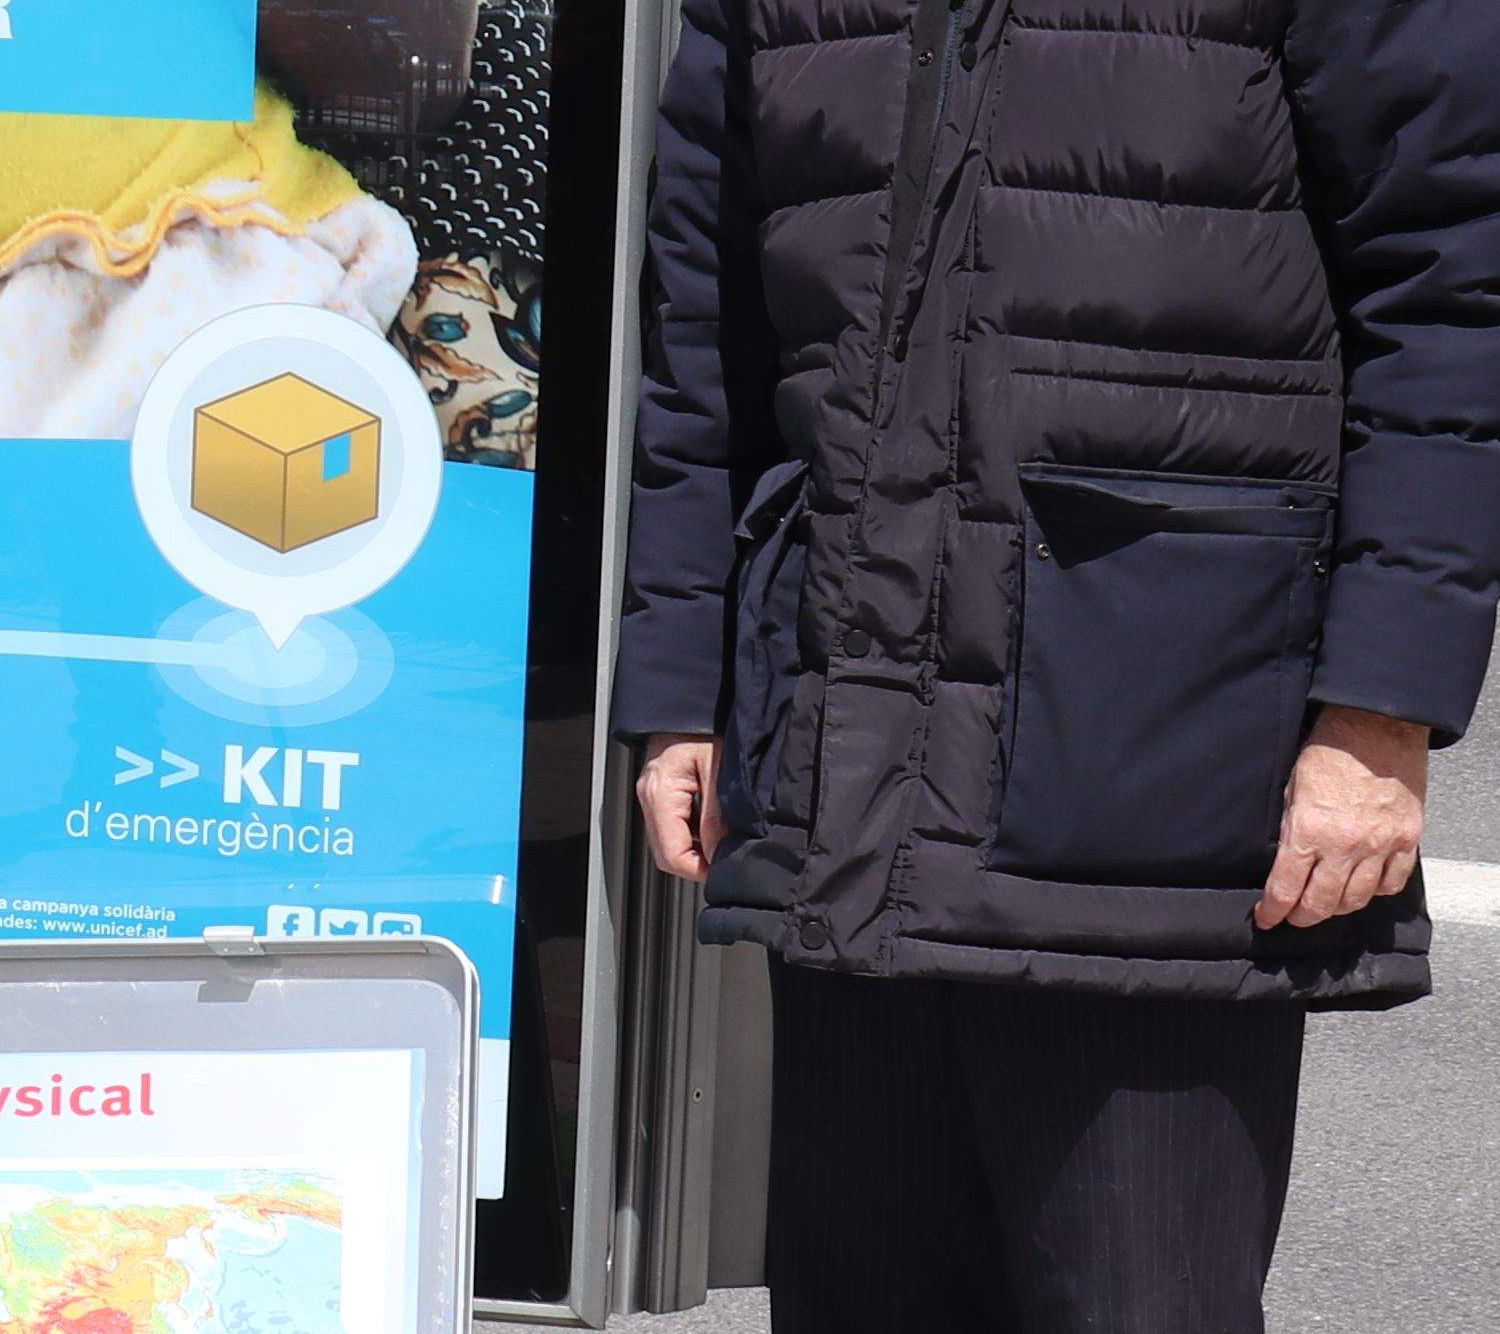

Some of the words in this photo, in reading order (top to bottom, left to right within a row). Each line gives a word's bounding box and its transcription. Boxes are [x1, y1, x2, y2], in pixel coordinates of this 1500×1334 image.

[223, 743, 360, 811] KIT
[12, 898, 100, 918] campanya
[103, 903, 176, 922] solidària
[42, 919, 168, 940] www.unicef.ad
